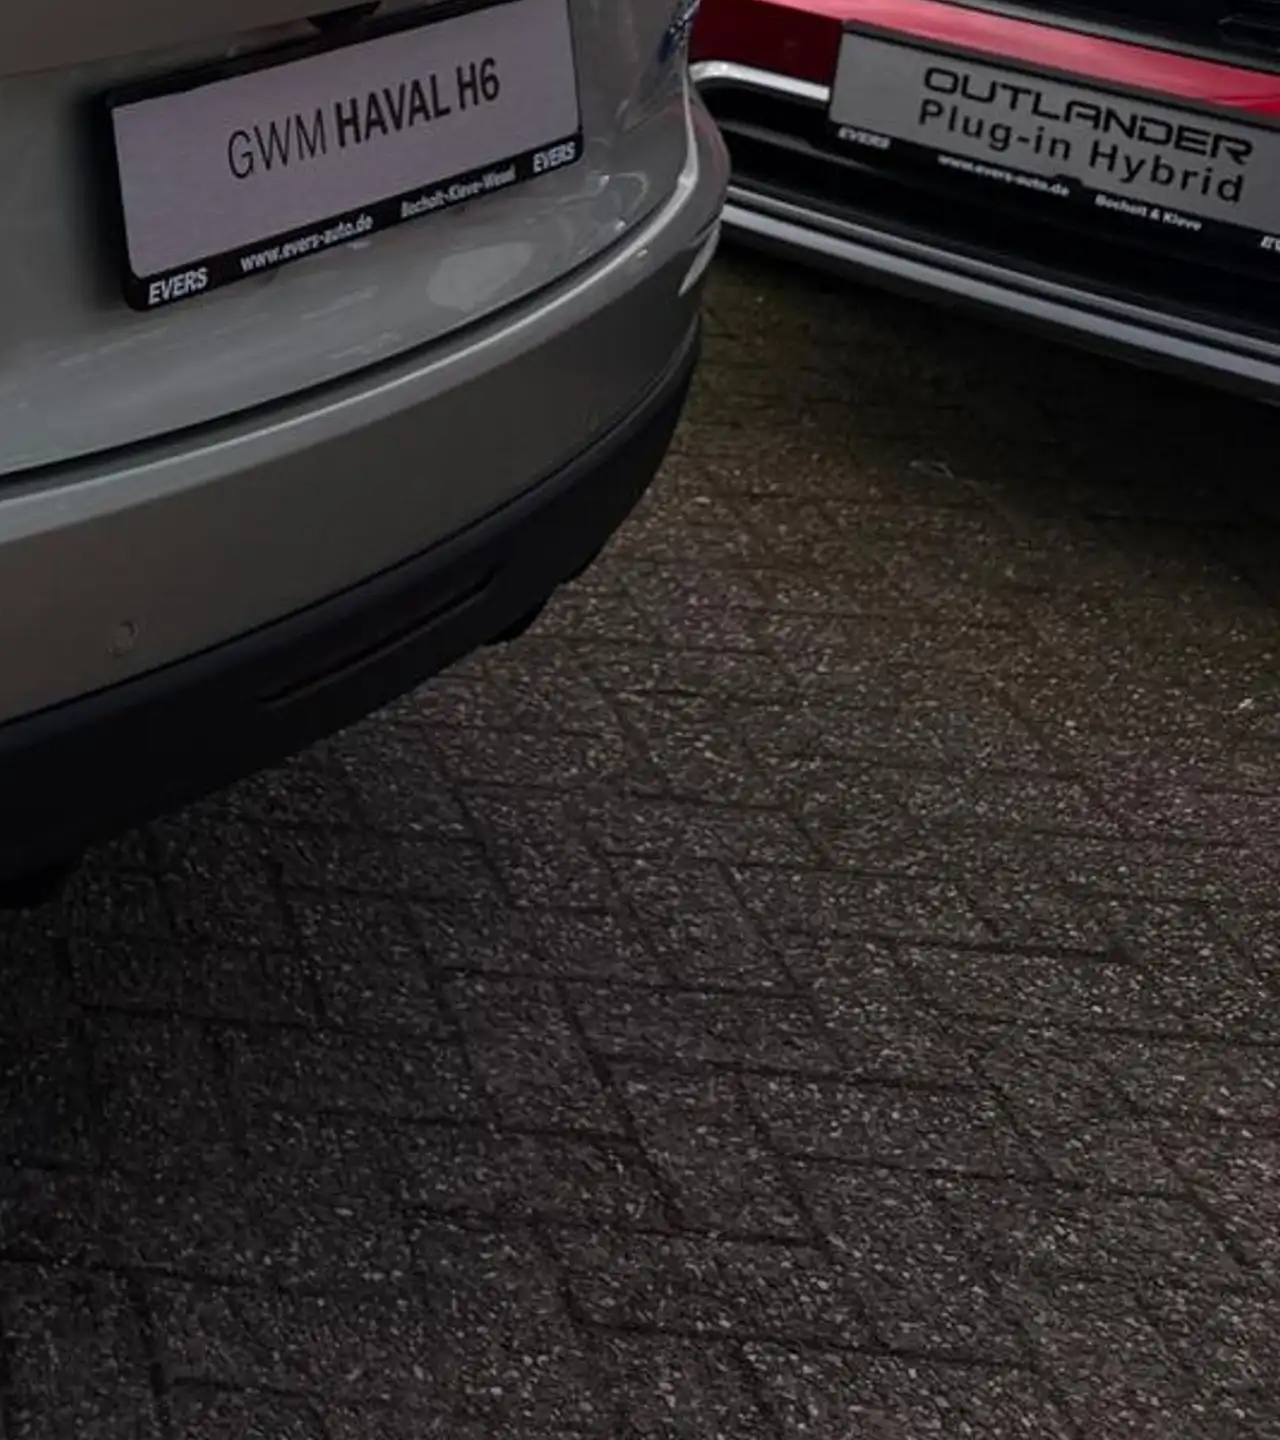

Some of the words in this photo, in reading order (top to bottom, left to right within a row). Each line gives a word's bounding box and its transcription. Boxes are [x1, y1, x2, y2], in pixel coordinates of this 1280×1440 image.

[227, 108, 327, 180] GWM
[334, 71, 452, 149] HAVAL
[456, 57, 501, 112] H6
[918, 98, 1072, 162] Plug-in
[1088, 139, 1244, 205] Hybrid
[924, 65, 1254, 165] OUTLANDER
[148, 266, 209, 305] EVERS
[240, 213, 374, 273] www.evers-auto.de
[533, 141, 577, 173] EVERS
